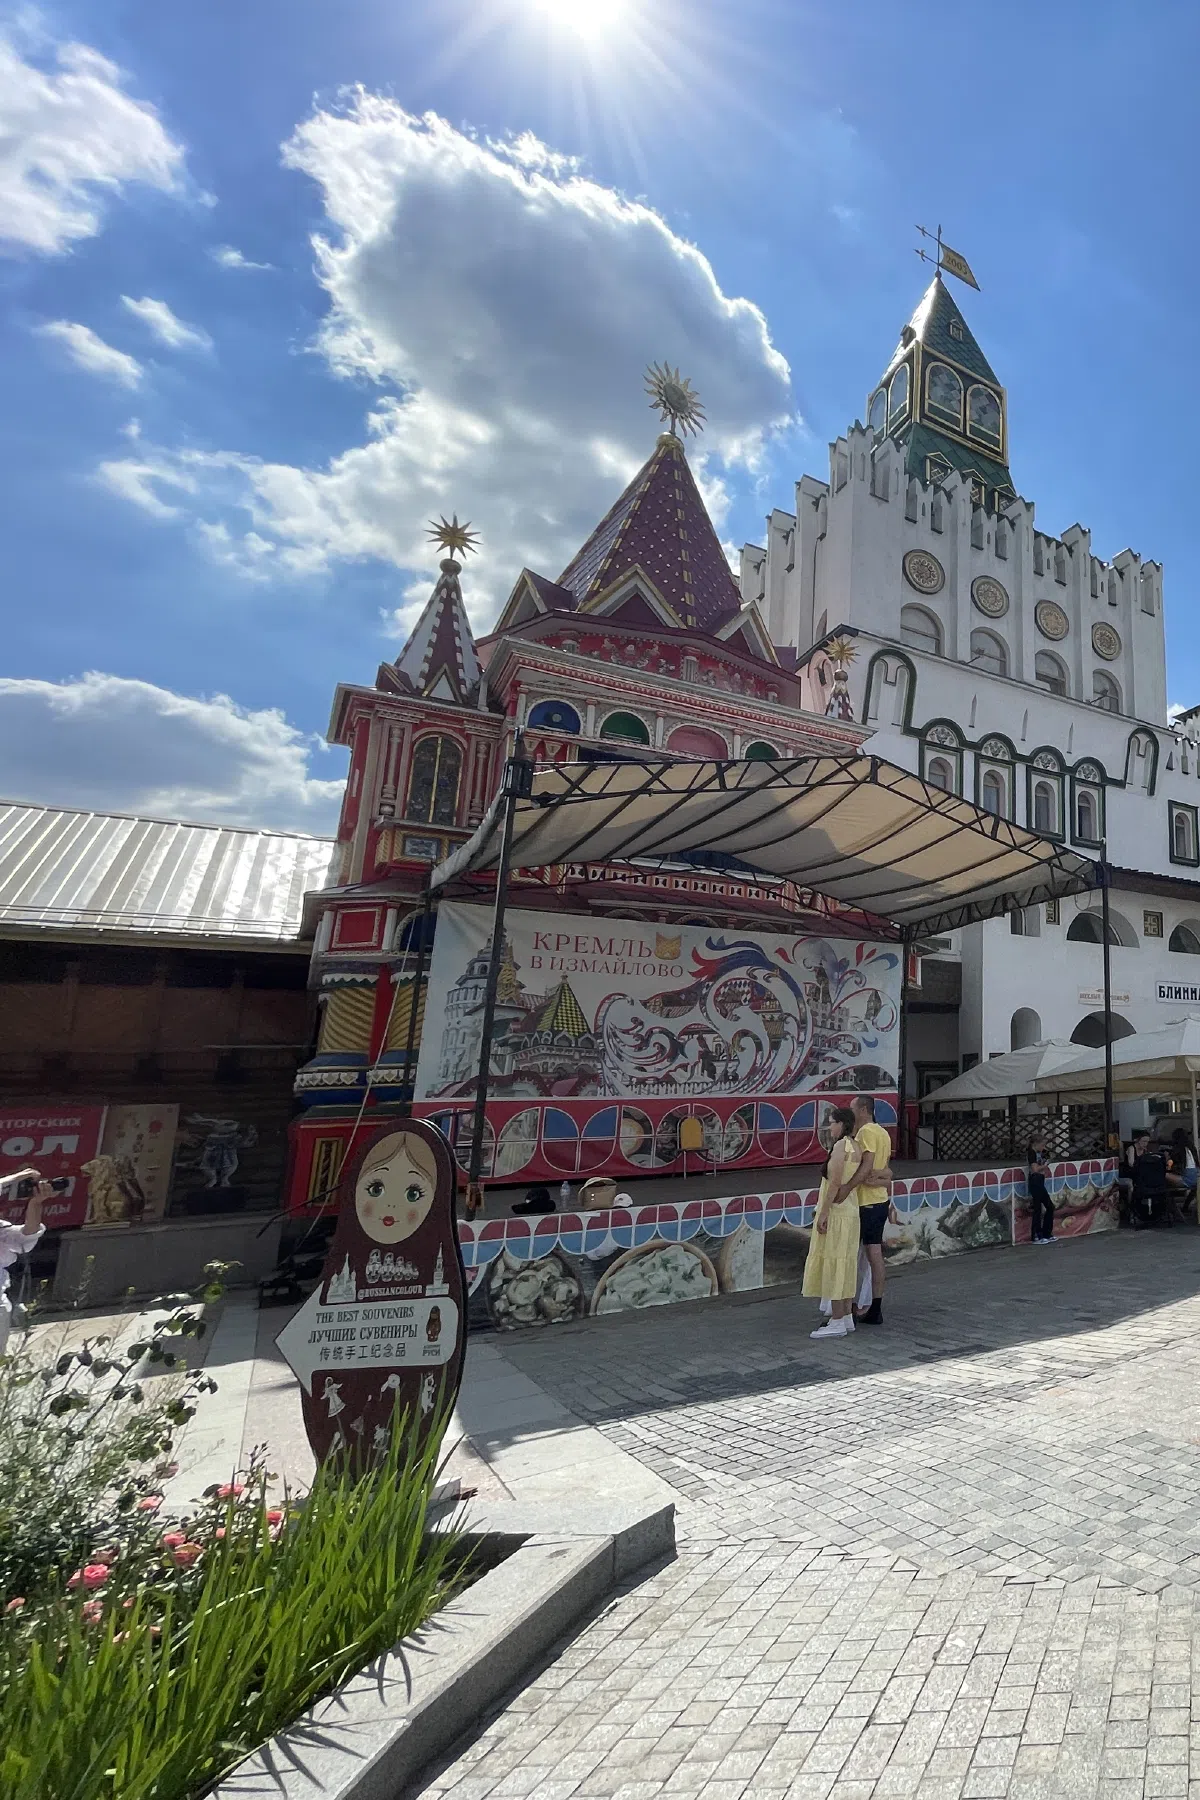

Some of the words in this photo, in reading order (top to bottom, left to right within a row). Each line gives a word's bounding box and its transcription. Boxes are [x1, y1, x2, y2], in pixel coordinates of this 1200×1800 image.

[532, 932, 652, 958] КРЕМЛЬ
[530, 955, 543, 969] В
[550, 956, 684, 978] ИЗМАЙЛОВО
[0, 1135, 79, 1156] ОЛ
[357, 1285, 423, 1299] @RUSSIANCOLOUR
[316, 1311, 334, 1324] THE
[337, 1310, 360, 1323] BEST
[362, 1306, 415, 1321] SOUVENIRS
[308, 1327, 357, 1344] ЛУЧШИЕ
[359, 1324, 418, 1340] СУВЕНИРЫ
[319, 1342, 407, 1362] 传统手工纪念品
